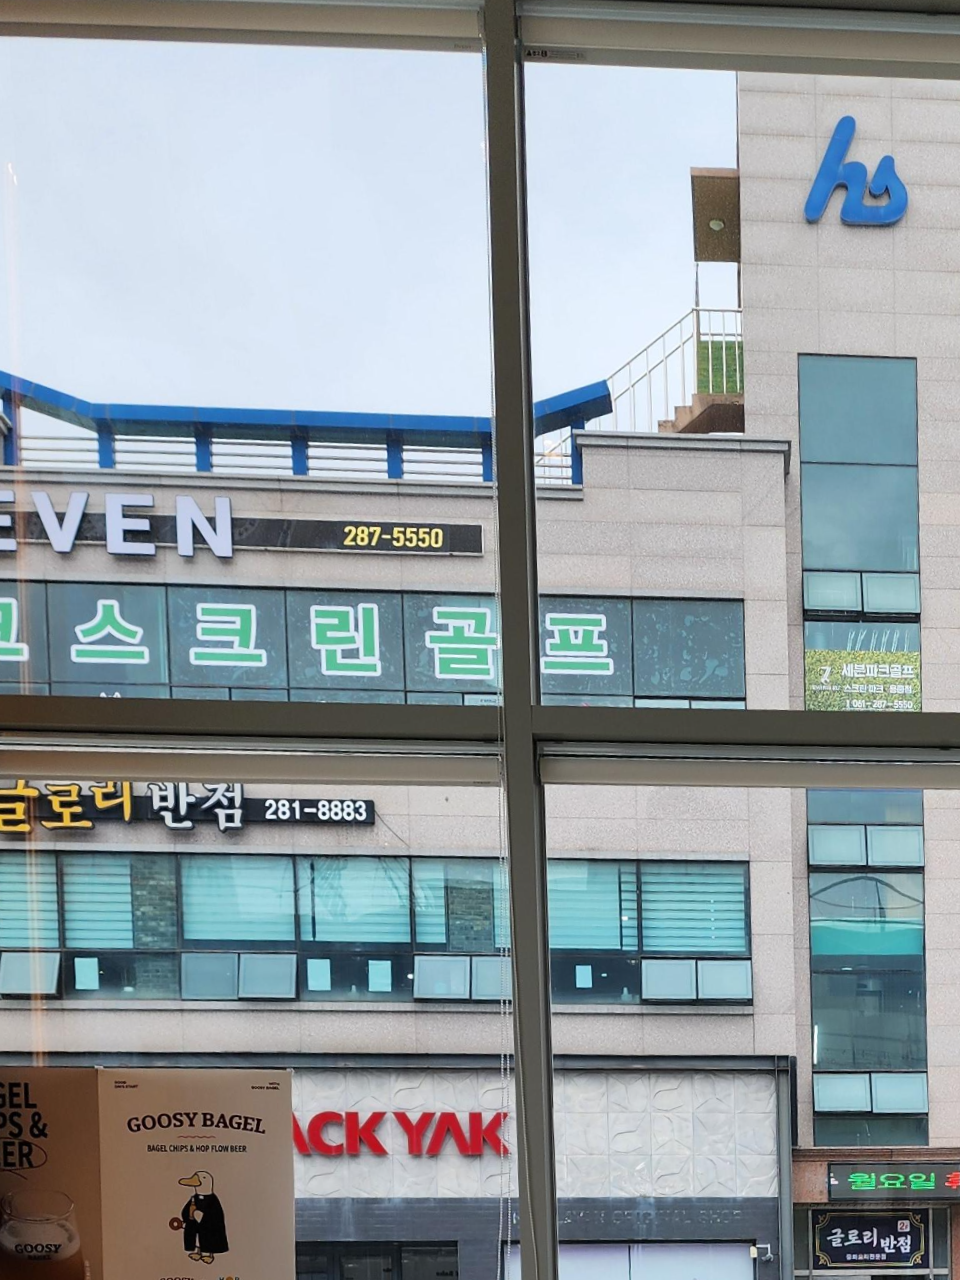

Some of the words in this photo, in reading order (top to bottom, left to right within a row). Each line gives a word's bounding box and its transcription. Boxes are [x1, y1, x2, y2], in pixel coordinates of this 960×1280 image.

[343, 525, 444, 548] 287-5550
[149, 781, 245, 832] 반점
[264, 798, 367, 822] 281-8883
[127, 1112, 198, 1133] GOOSY
[201, 1112, 266, 1134] BAGEL
[147, 1144, 168, 1153] BAGEL
[169, 1144, 189, 1153] CHIPS
[196, 1144, 210, 1153] HOP
[211, 1144, 230, 1153] FLOW
[230, 1144, 247, 1153] BEER
[848, 1172, 936, 1190] 월요일
[15, 1243, 62, 1254] GOOSY
[826, 1228, 878, 1248] 글로리
[880, 1235, 912, 1254] 반점
